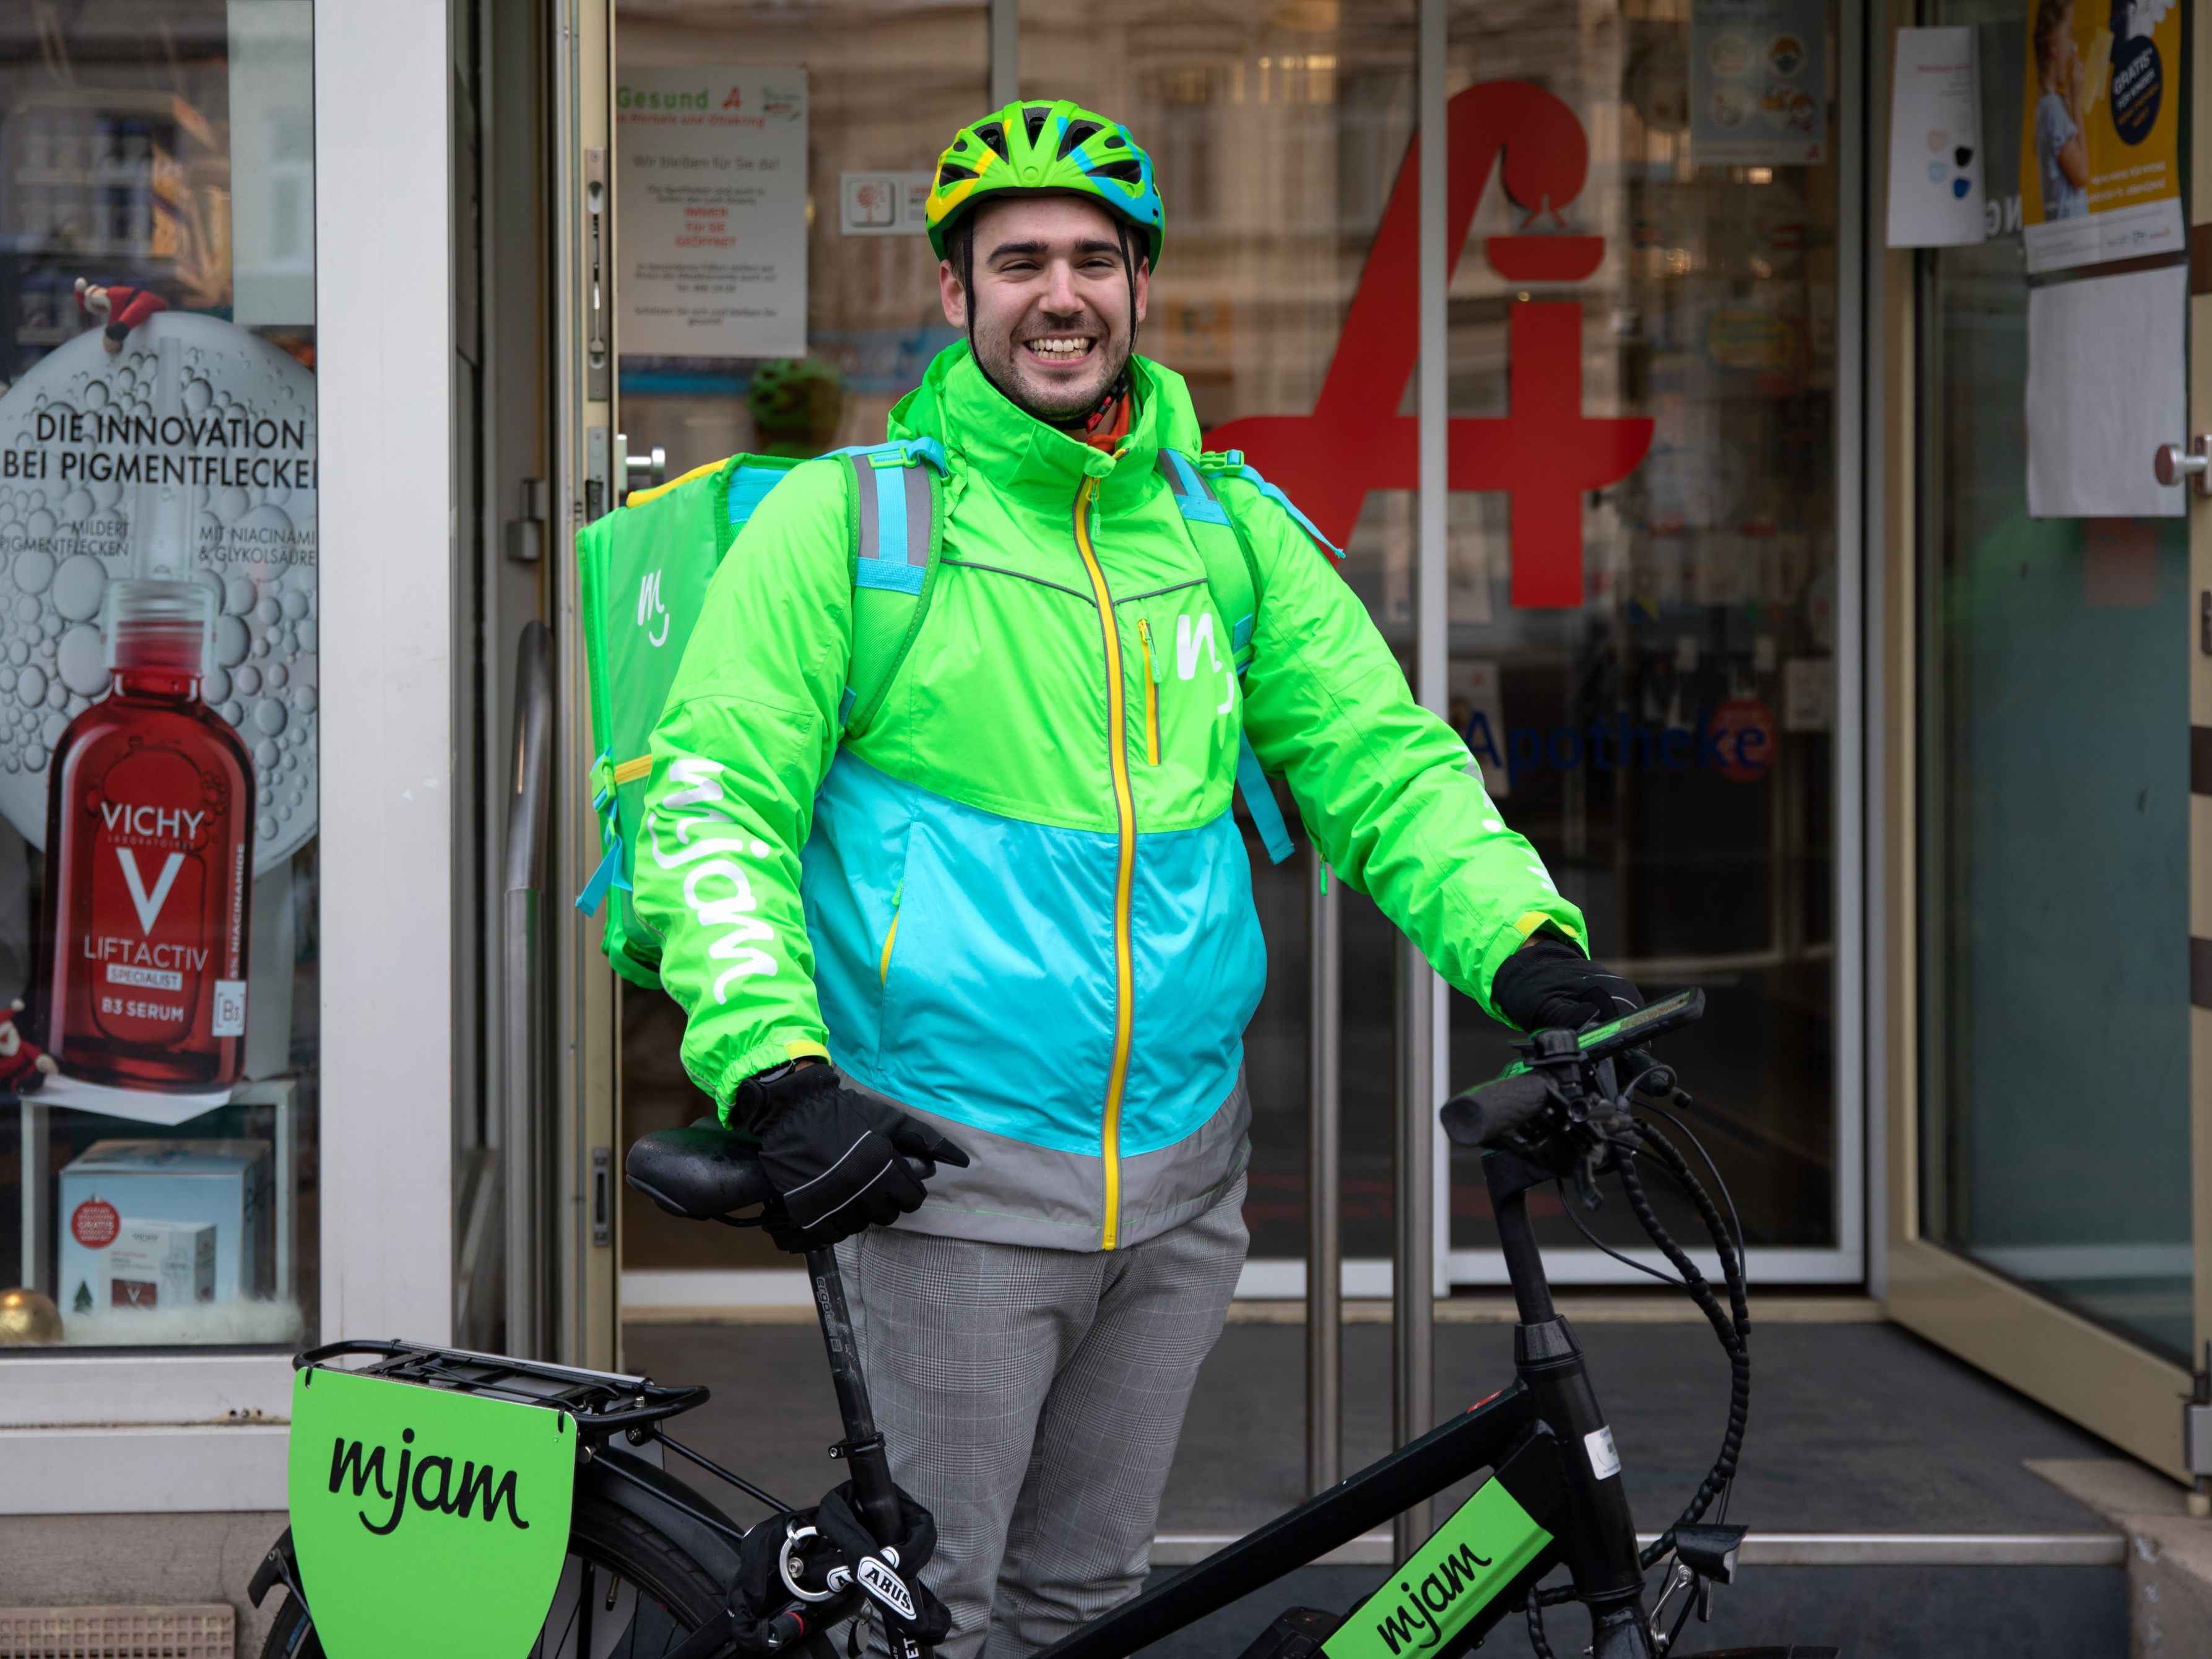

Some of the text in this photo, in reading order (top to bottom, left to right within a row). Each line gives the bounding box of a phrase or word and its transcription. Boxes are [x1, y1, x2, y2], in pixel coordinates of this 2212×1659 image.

[617, 85, 708, 110] Gesund
[680, 114, 705, 125] und
[36, 413, 305, 450] DIE INNOVATION
[2, 449, 46, 479] BEI
[71, 520, 131, 538] MILDERT
[199, 526, 224, 542] MIT
[198, 545, 209, 561] &
[1464, 711, 1766, 786] Apotheke
[100, 801, 205, 840] VICHY
[232, 842, 245, 953] NIACINAMIDE
[647, 758, 778, 1005] mjam
[84, 934, 209, 972] LIFTACTIV
[110, 967, 179, 989] SPECIALIST
[102, 996, 184, 1023] B3 SERUM
[329, 1427, 530, 1536] mjam
[864, 1566, 911, 1611] ABUS
[1376, 1542, 1493, 1655] mjam
